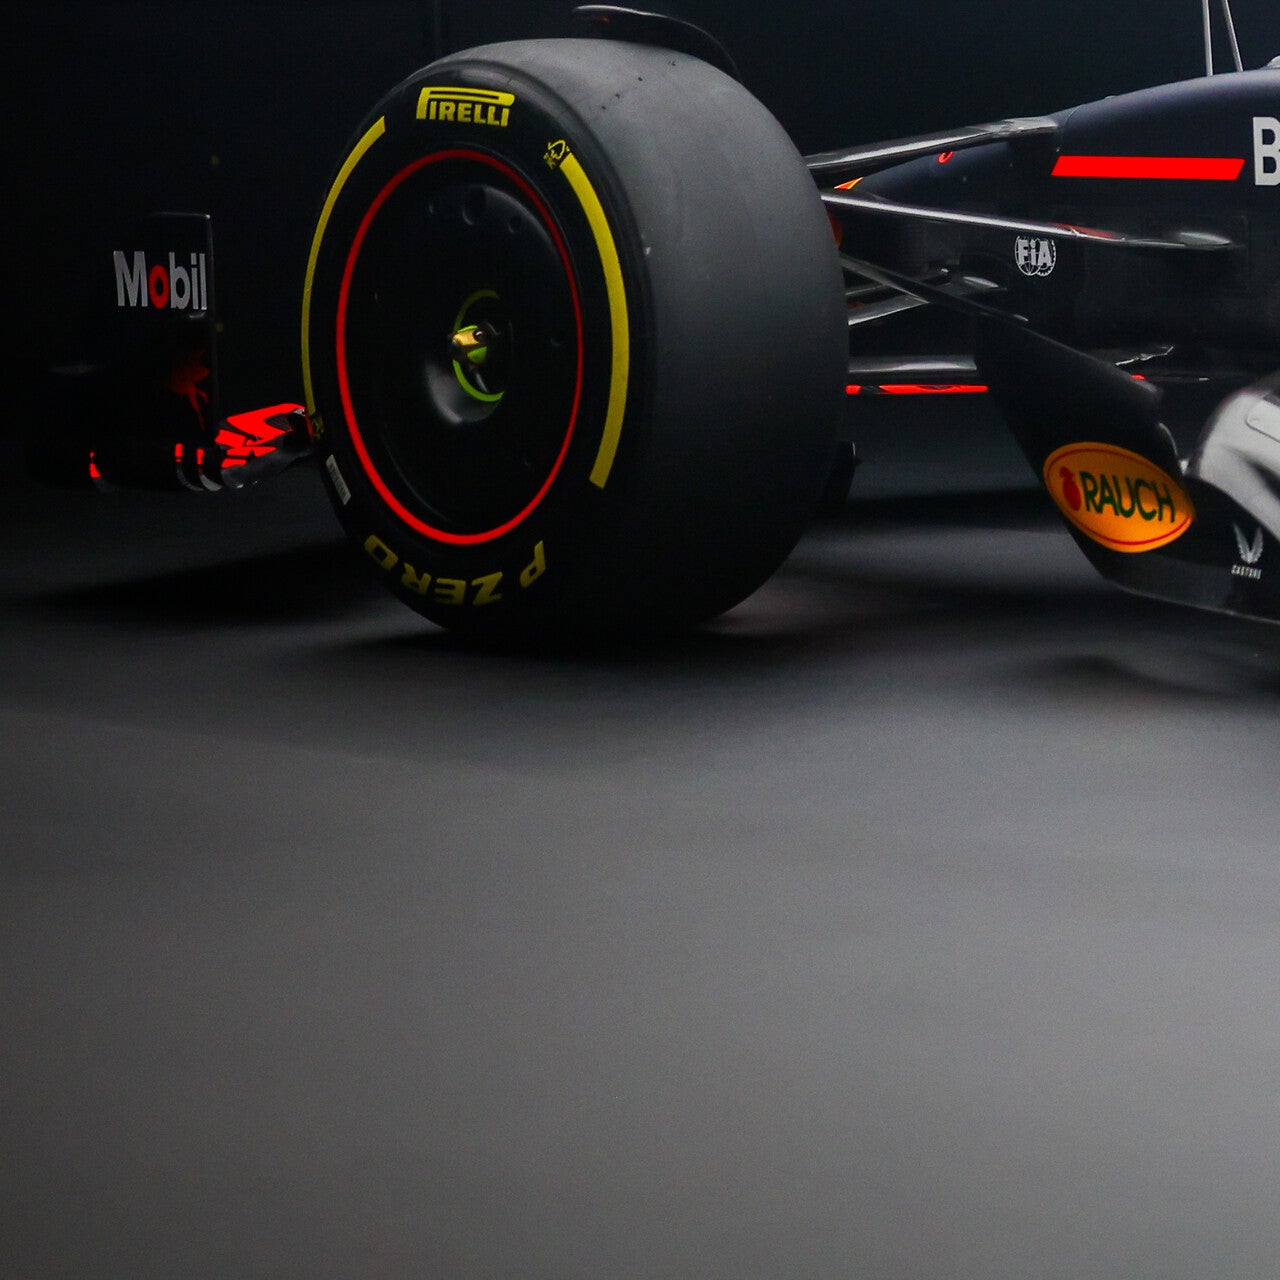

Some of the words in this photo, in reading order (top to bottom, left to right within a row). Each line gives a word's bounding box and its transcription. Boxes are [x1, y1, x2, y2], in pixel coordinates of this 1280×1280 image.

[415, 86, 516, 127] PIRELLI
[112, 249, 208, 311] Mobil
[1079, 470, 1176, 523] RAUCH
[364, 534, 503, 606] ZERO
[519, 540, 547, 588] P
